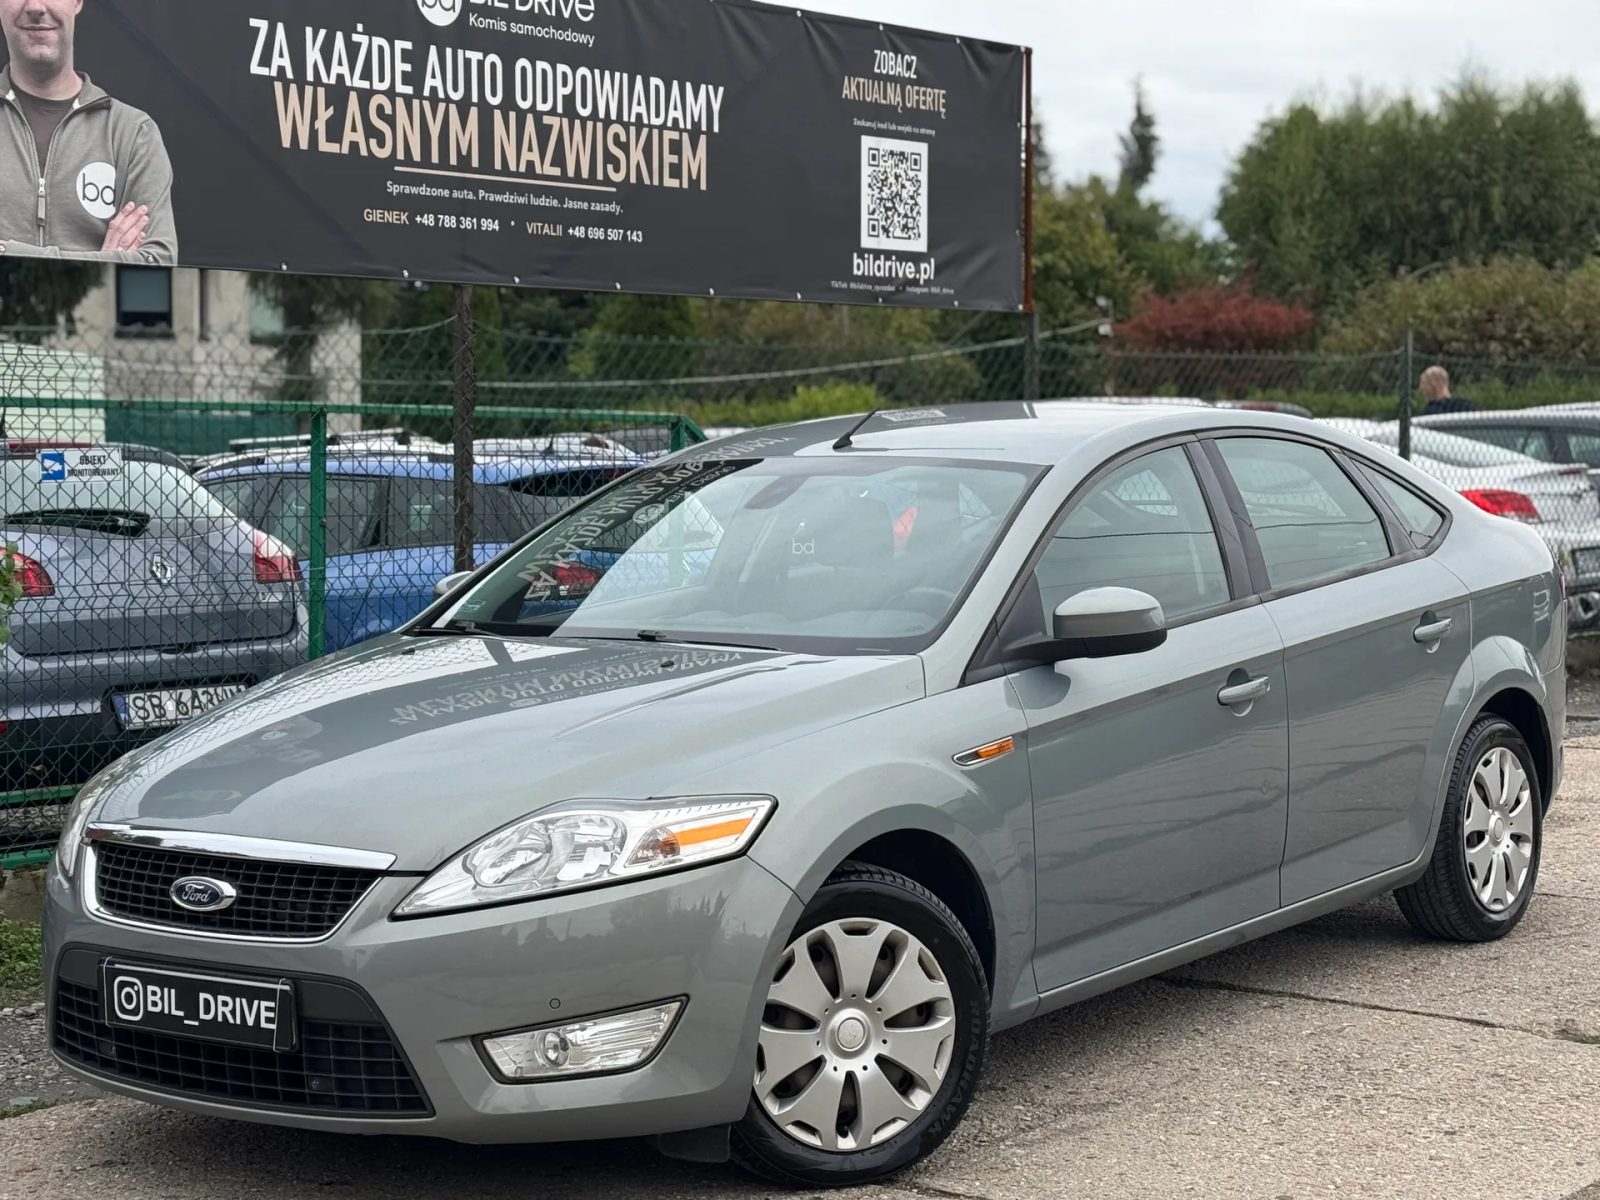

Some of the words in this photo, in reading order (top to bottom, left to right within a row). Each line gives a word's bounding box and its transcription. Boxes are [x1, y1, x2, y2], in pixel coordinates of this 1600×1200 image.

[469, 12, 507, 32] Komis
[510, 22, 595, 47] samochodowy
[249, 17, 294, 79] ZA
[305, 23, 414, 94] KAŻDE
[423, 44, 503, 105] AUTO
[515, 57, 725, 133] ODPOWIADAMY
[873, 49, 918, 79] ZOBACZ
[842, 76, 903, 113] AKTUALNĄ
[905, 85, 947, 119] OFERTĘ
[273, 80, 479, 168] WŁASNYM
[493, 108, 708, 191] NAZWISKIEM
[386, 181, 450, 197] Sprawdzone
[452, 189, 477, 200] auta.
[479, 189, 528, 205] Prawdziwi
[530, 193, 561, 208] ludzie.
[563, 197, 589, 210] Jasne
[590, 201, 624, 216] zasady.
[363, 208, 410, 225] GIENEK
[415, 213, 435, 227] +48
[438, 214, 457, 229] 788
[459, 216, 477, 230] 361
[480, 218, 500, 232] 994
[526, 221, 563, 237] VITALII
[568, 226, 585, 239] +48
[588, 227, 605, 240] 696
[607, 228, 624, 242] 507
[626, 230, 643, 243] 143
[853, 252, 935, 285] bildrive.pl
[792, 537, 815, 554] bd
[132, 694, 167, 721] SB
[181, 883, 212, 903] Ford
[146, 984, 276, 1030] BIL_DRIVE
